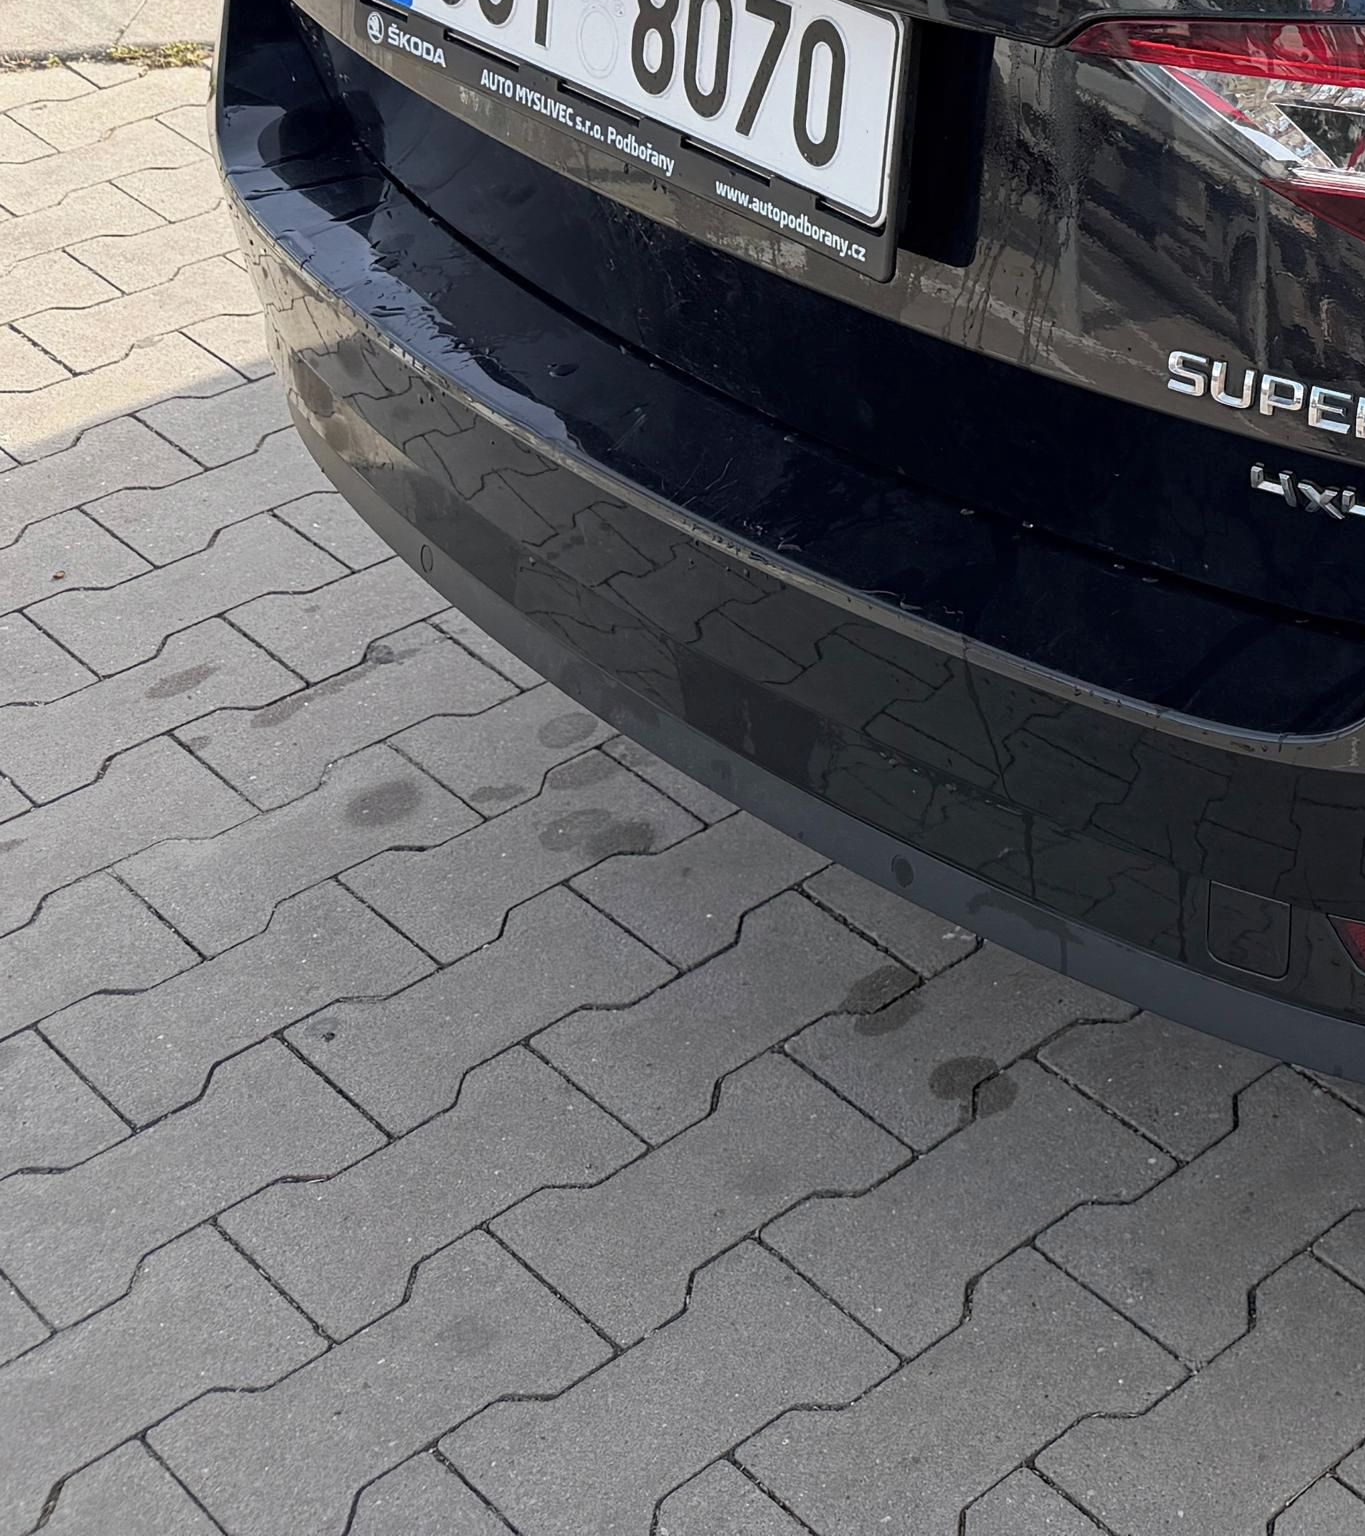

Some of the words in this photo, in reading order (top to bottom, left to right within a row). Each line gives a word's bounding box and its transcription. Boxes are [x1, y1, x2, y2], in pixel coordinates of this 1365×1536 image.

[387, 22, 447, 68] ŠKODA
[480, 68, 514, 99] AUTO
[515, 83, 574, 128] MYSLIVEC
[574, 117, 605, 142] s.r.o.
[607, 125, 676, 177] Podbořany
[715, 180, 868, 263] www.autopodborany.cz
